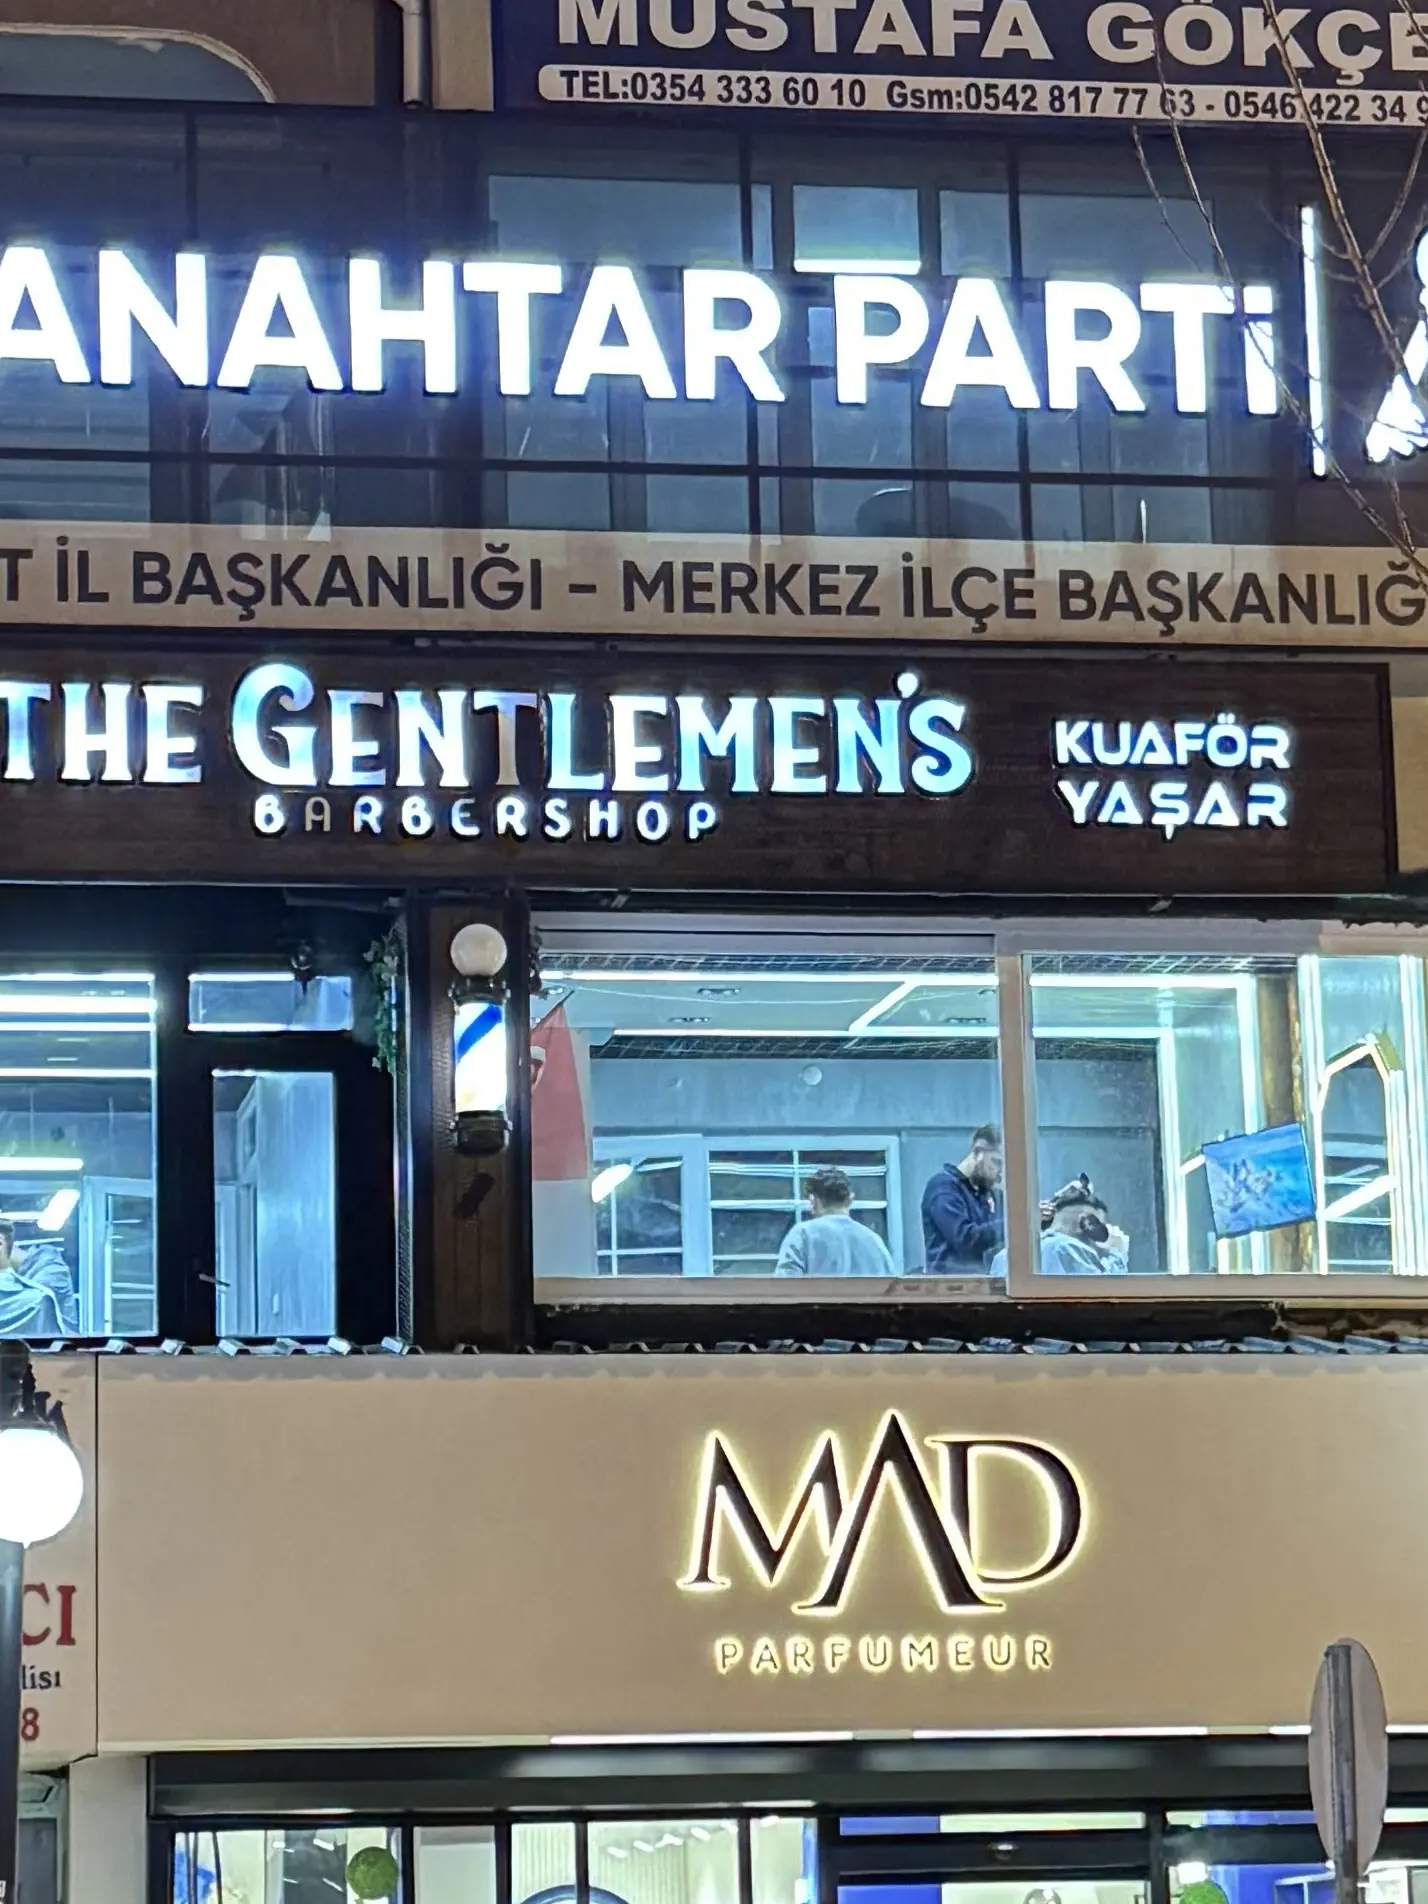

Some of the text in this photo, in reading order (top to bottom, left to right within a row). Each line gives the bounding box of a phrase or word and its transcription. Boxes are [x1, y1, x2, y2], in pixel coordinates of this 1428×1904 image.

[559, 70, 706, 105] TEL:0354
[715, 73, 773, 106] 333
[782, 76, 820, 108] 60
[829, 78, 867, 109] 10
[1048, 83, 1104, 115] 817
[1113, 85, 1149, 117] 77
[1224, 90, 1297, 122] 0546
[1308, 92, 1362, 123] 422
[1371, 94, 1407, 124] 34
[55, 535, 112, 604] İL
[133, 543, 544, 622] BAŞKANLIĞI
[622, 559, 881, 619] MERKEZ
[901, 550, 1036, 633] İLÇE
[1053, 712, 1291, 771] KUAFÖR
[1057, 779, 1289, 839] YAŞAR
[676, 1408, 1088, 1616] MAD
[715, 1634, 1054, 1675] PARFUMEUR
